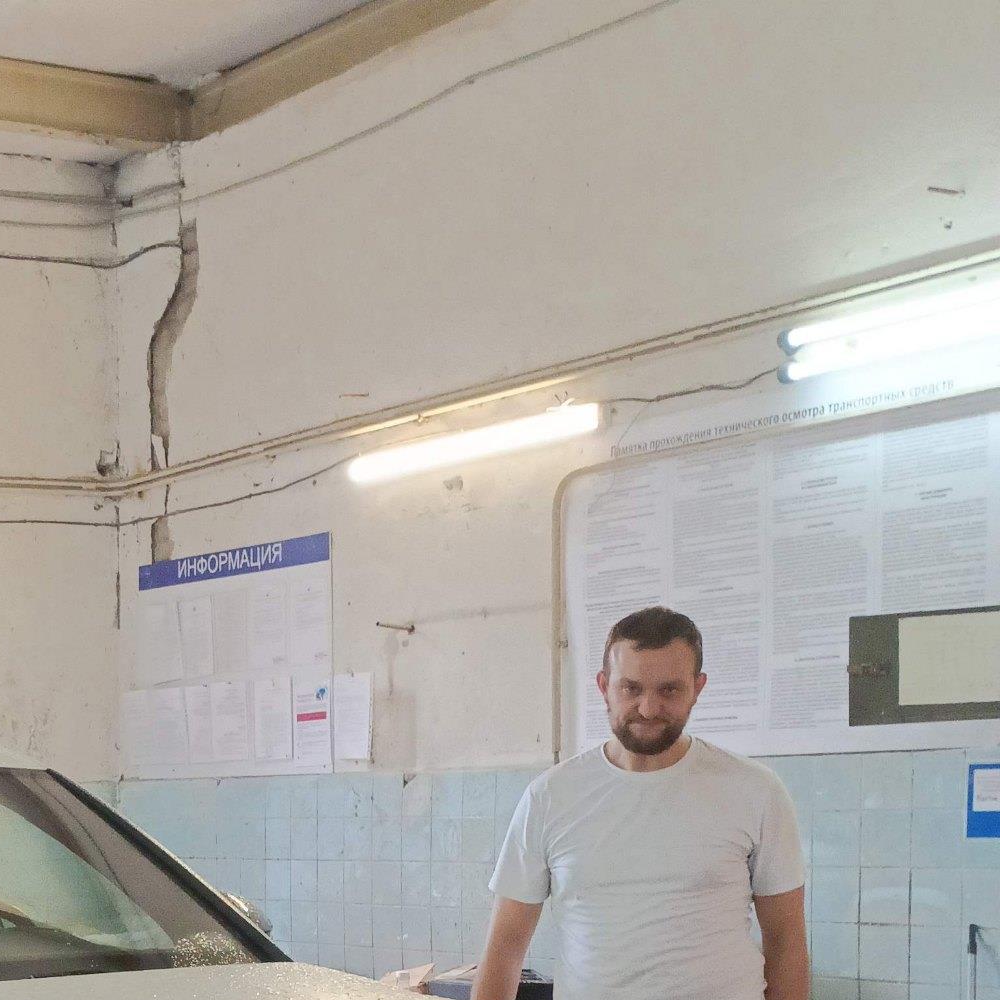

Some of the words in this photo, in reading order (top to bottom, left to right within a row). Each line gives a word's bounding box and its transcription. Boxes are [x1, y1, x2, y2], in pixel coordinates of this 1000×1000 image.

[610, 442, 648, 457] Памятка
[650, 427, 711, 450] прохождения
[714, 414, 779, 436] технического
[782, 405, 825, 422] осмотра
[828, 389, 906, 413] транспортных
[909, 379, 955, 400] средств
[177, 543, 282, 579] ИНФОРМАЦИЯ
